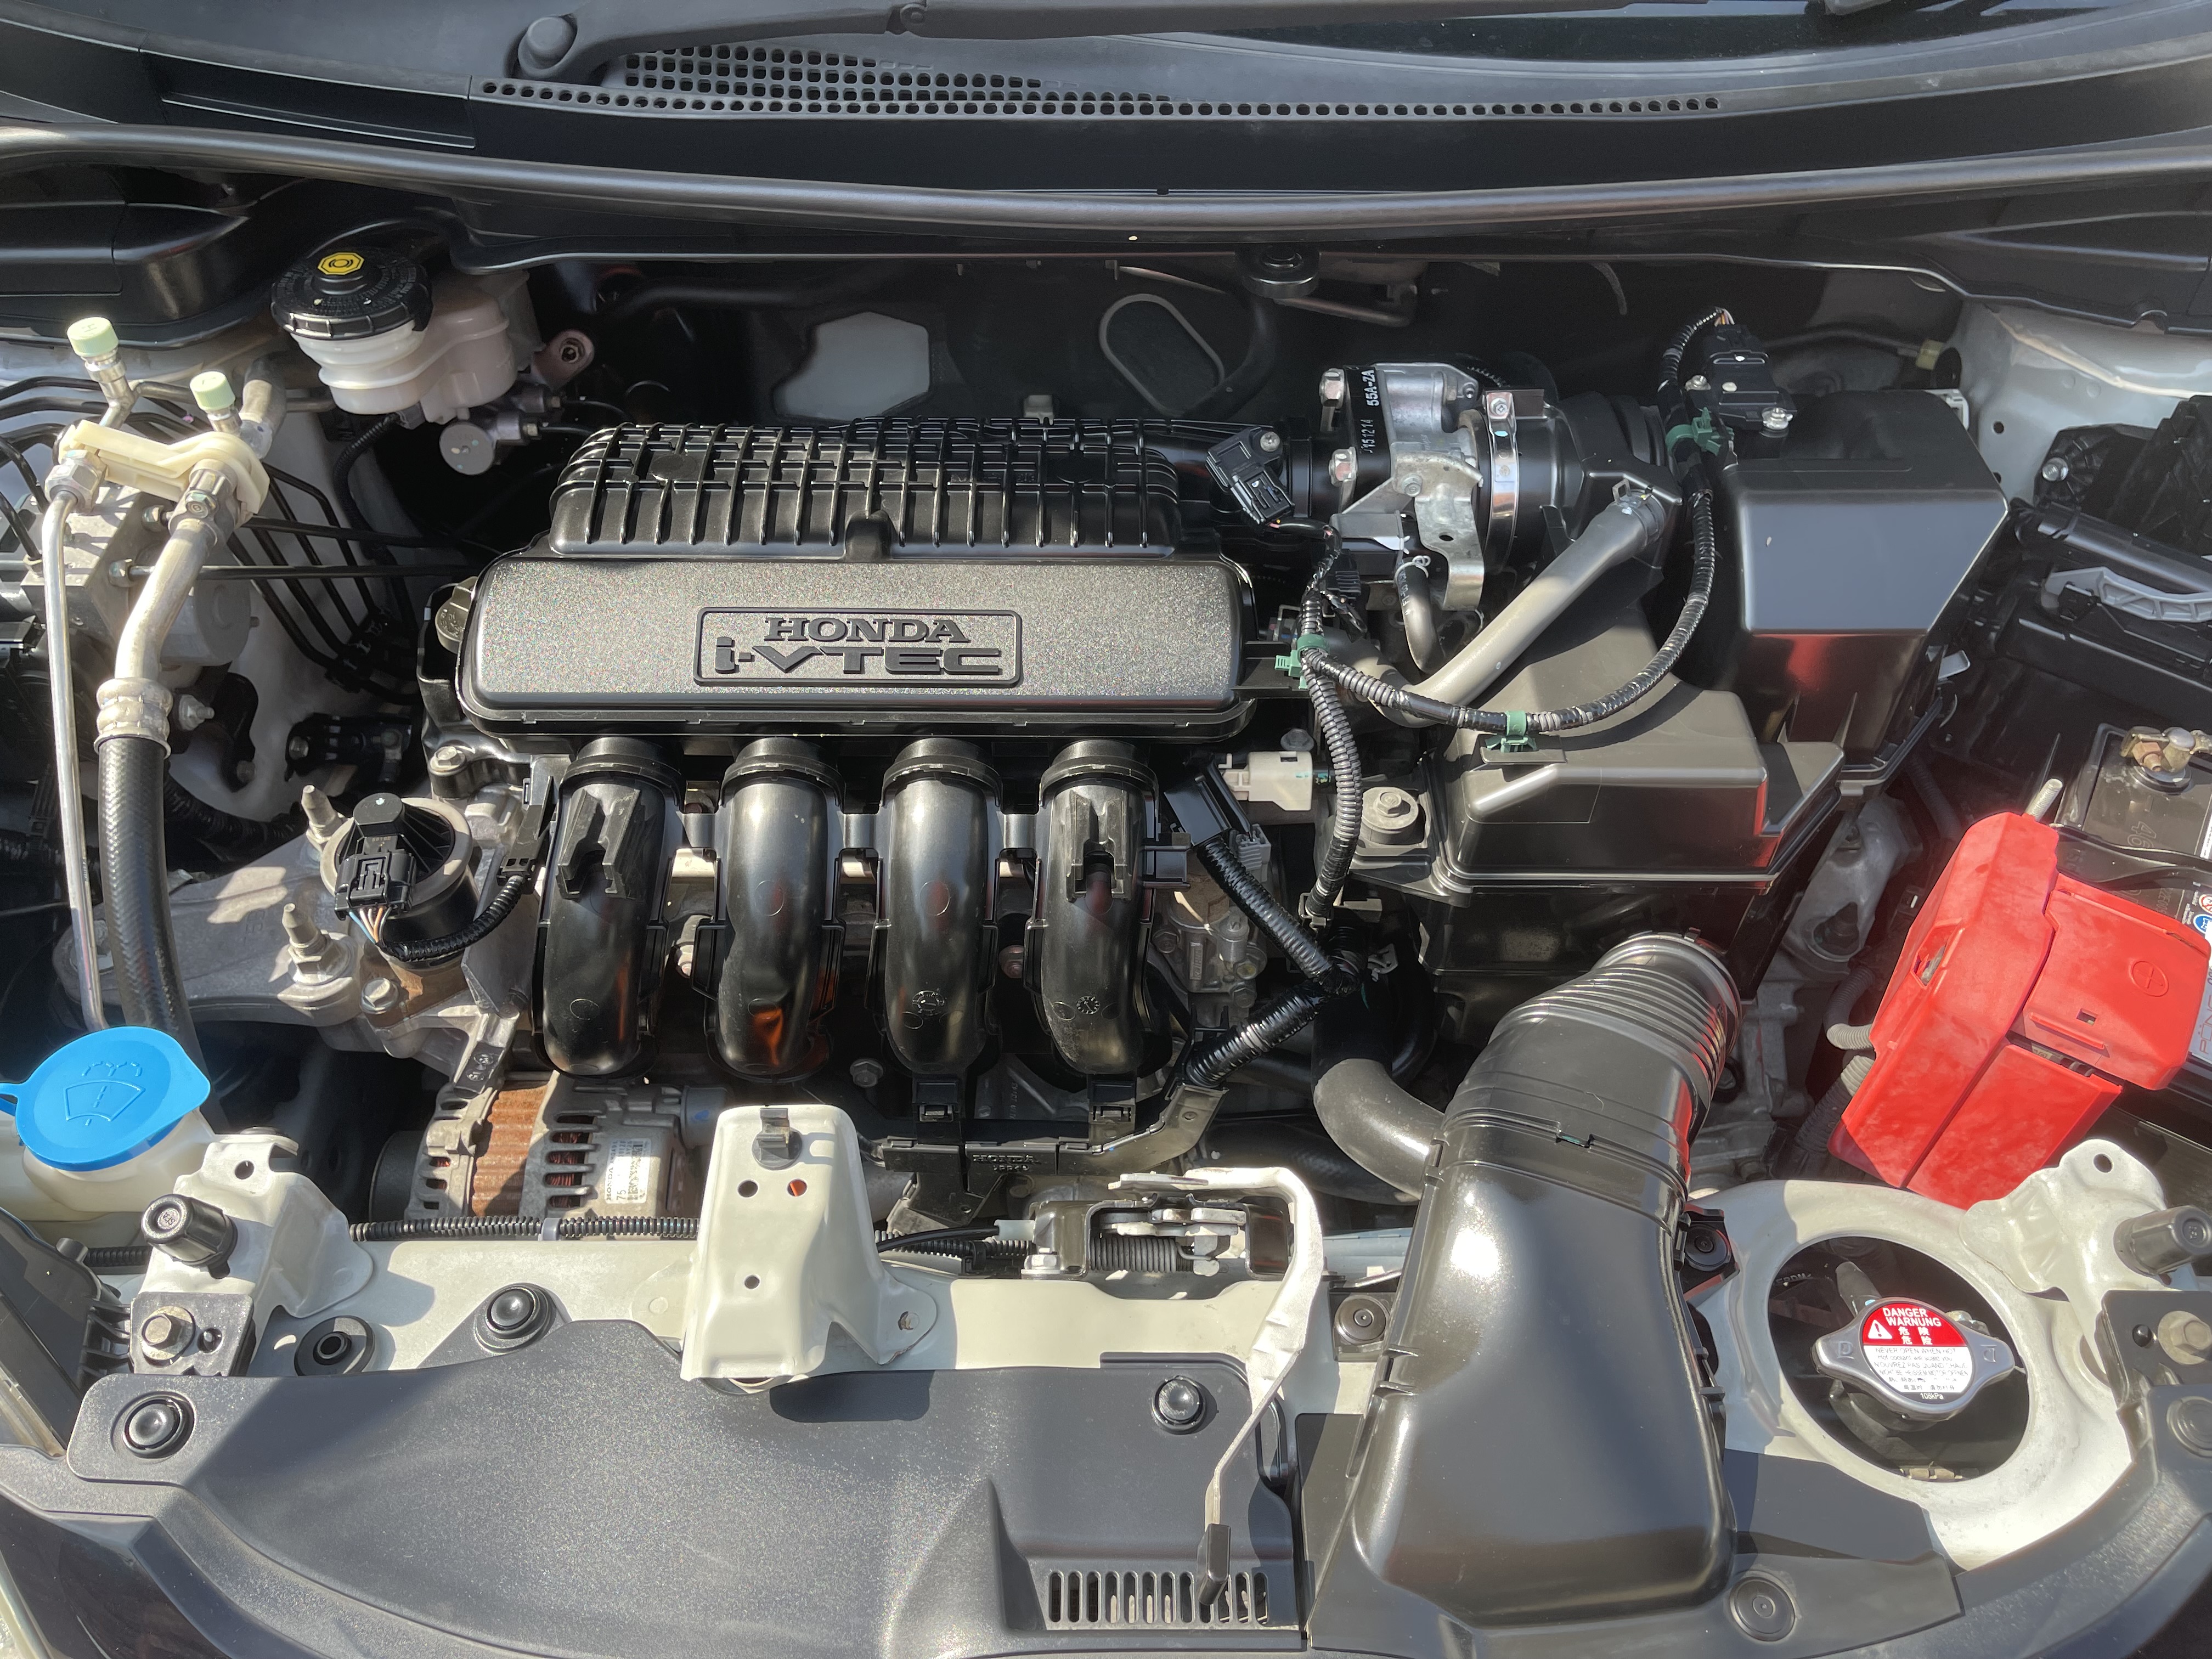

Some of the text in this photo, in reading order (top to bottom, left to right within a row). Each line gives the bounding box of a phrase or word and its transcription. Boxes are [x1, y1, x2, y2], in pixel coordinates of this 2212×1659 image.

[764, 617, 970, 644] HONDA
[715, 637, 1003, 674] i-VTEC
[1882, 1307, 1928, 1317] DANGER
[1886, 1317, 1942, 1327] WARNUNG
